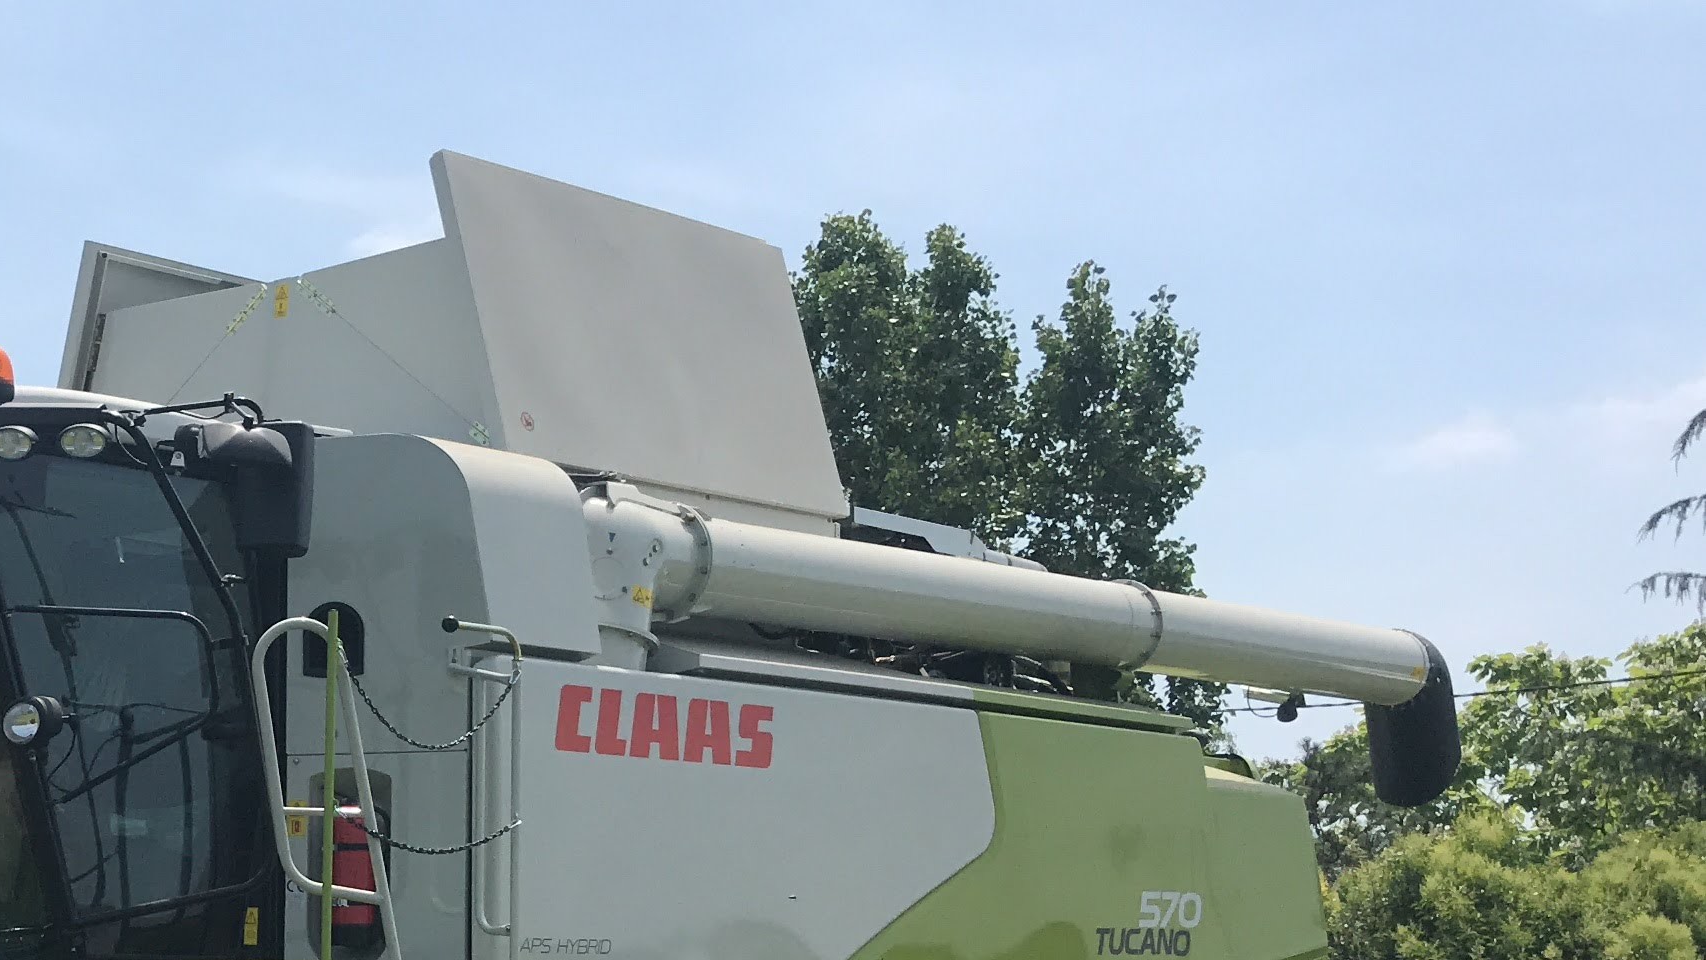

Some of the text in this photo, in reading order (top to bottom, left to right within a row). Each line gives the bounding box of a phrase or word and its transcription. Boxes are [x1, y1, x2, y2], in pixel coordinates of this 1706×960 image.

[555, 684, 774, 768] CLAAS
[1138, 891, 1202, 928] 570
[520, 938, 612, 954] APS HYBRID
[1096, 927, 1191, 957] TUCANO
